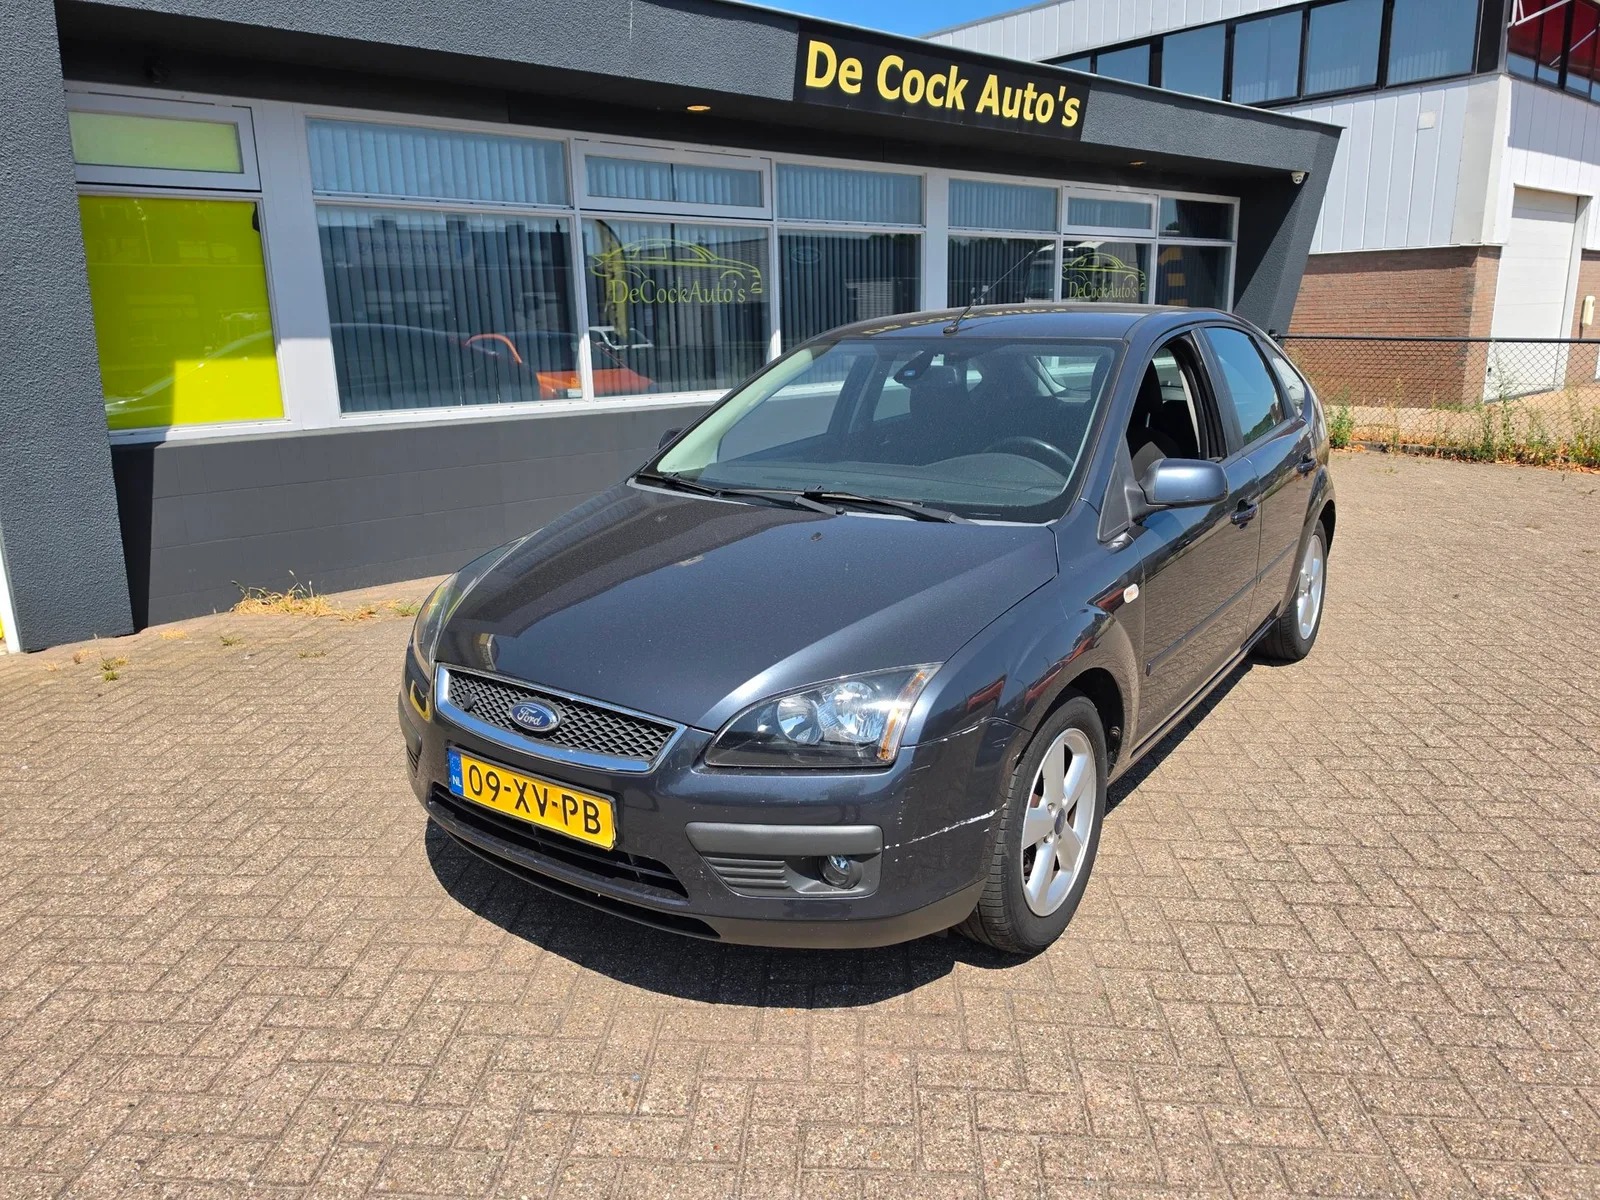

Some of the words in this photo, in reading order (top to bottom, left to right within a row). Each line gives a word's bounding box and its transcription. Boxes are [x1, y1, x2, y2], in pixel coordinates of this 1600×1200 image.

[805, 40, 863, 94] De
[876, 54, 969, 110] Cock
[976, 74, 1081, 127] Auto's
[609, 277, 746, 303] DeCockAuto's
[1069, 280, 1137, 299] DeCockAuto's
[517, 706, 543, 726] Ford
[452, 775, 462, 788] NL
[468, 764, 602, 835] 09-XV-PB
